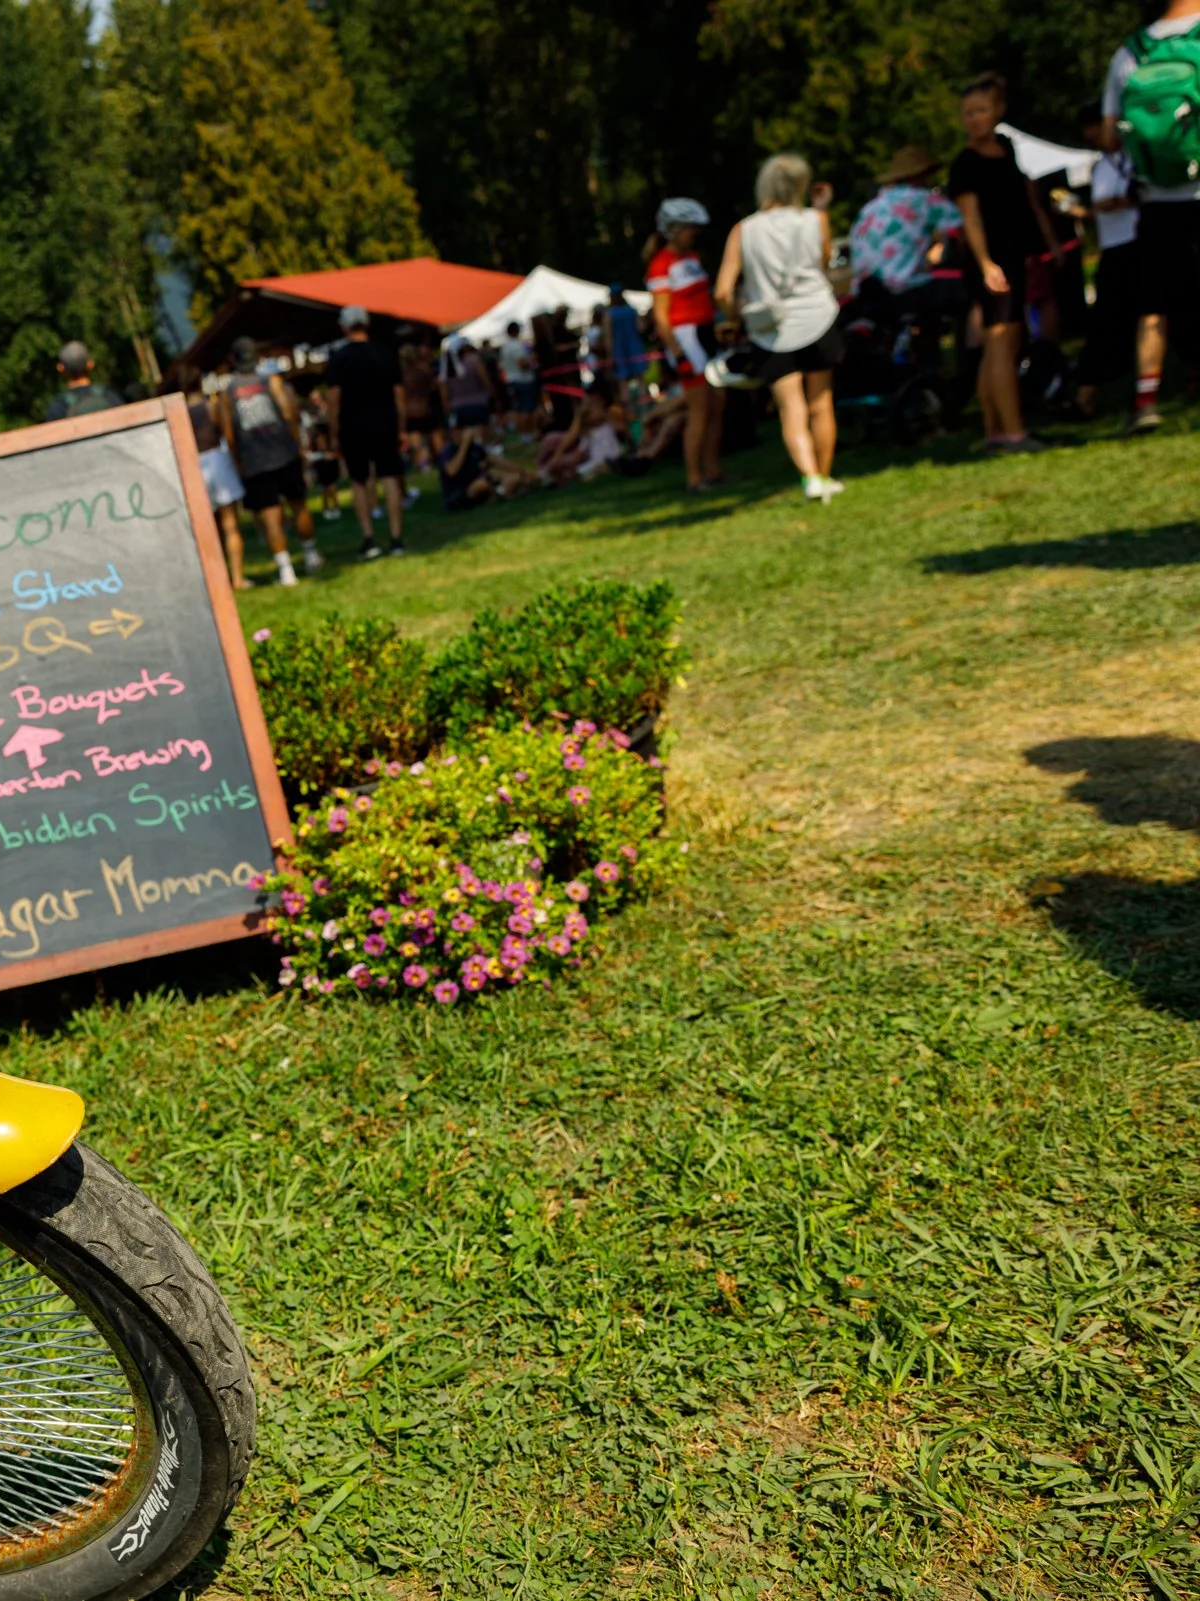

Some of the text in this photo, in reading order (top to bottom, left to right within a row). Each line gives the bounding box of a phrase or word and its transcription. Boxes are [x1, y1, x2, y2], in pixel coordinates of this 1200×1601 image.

[12, 563, 124, 610] Stand
[10, 669, 185, 724] Bouquets
[84, 738, 212, 776] Brewing
[128, 779, 258, 832] Spirits
[100, 855, 263, 916] Momma
